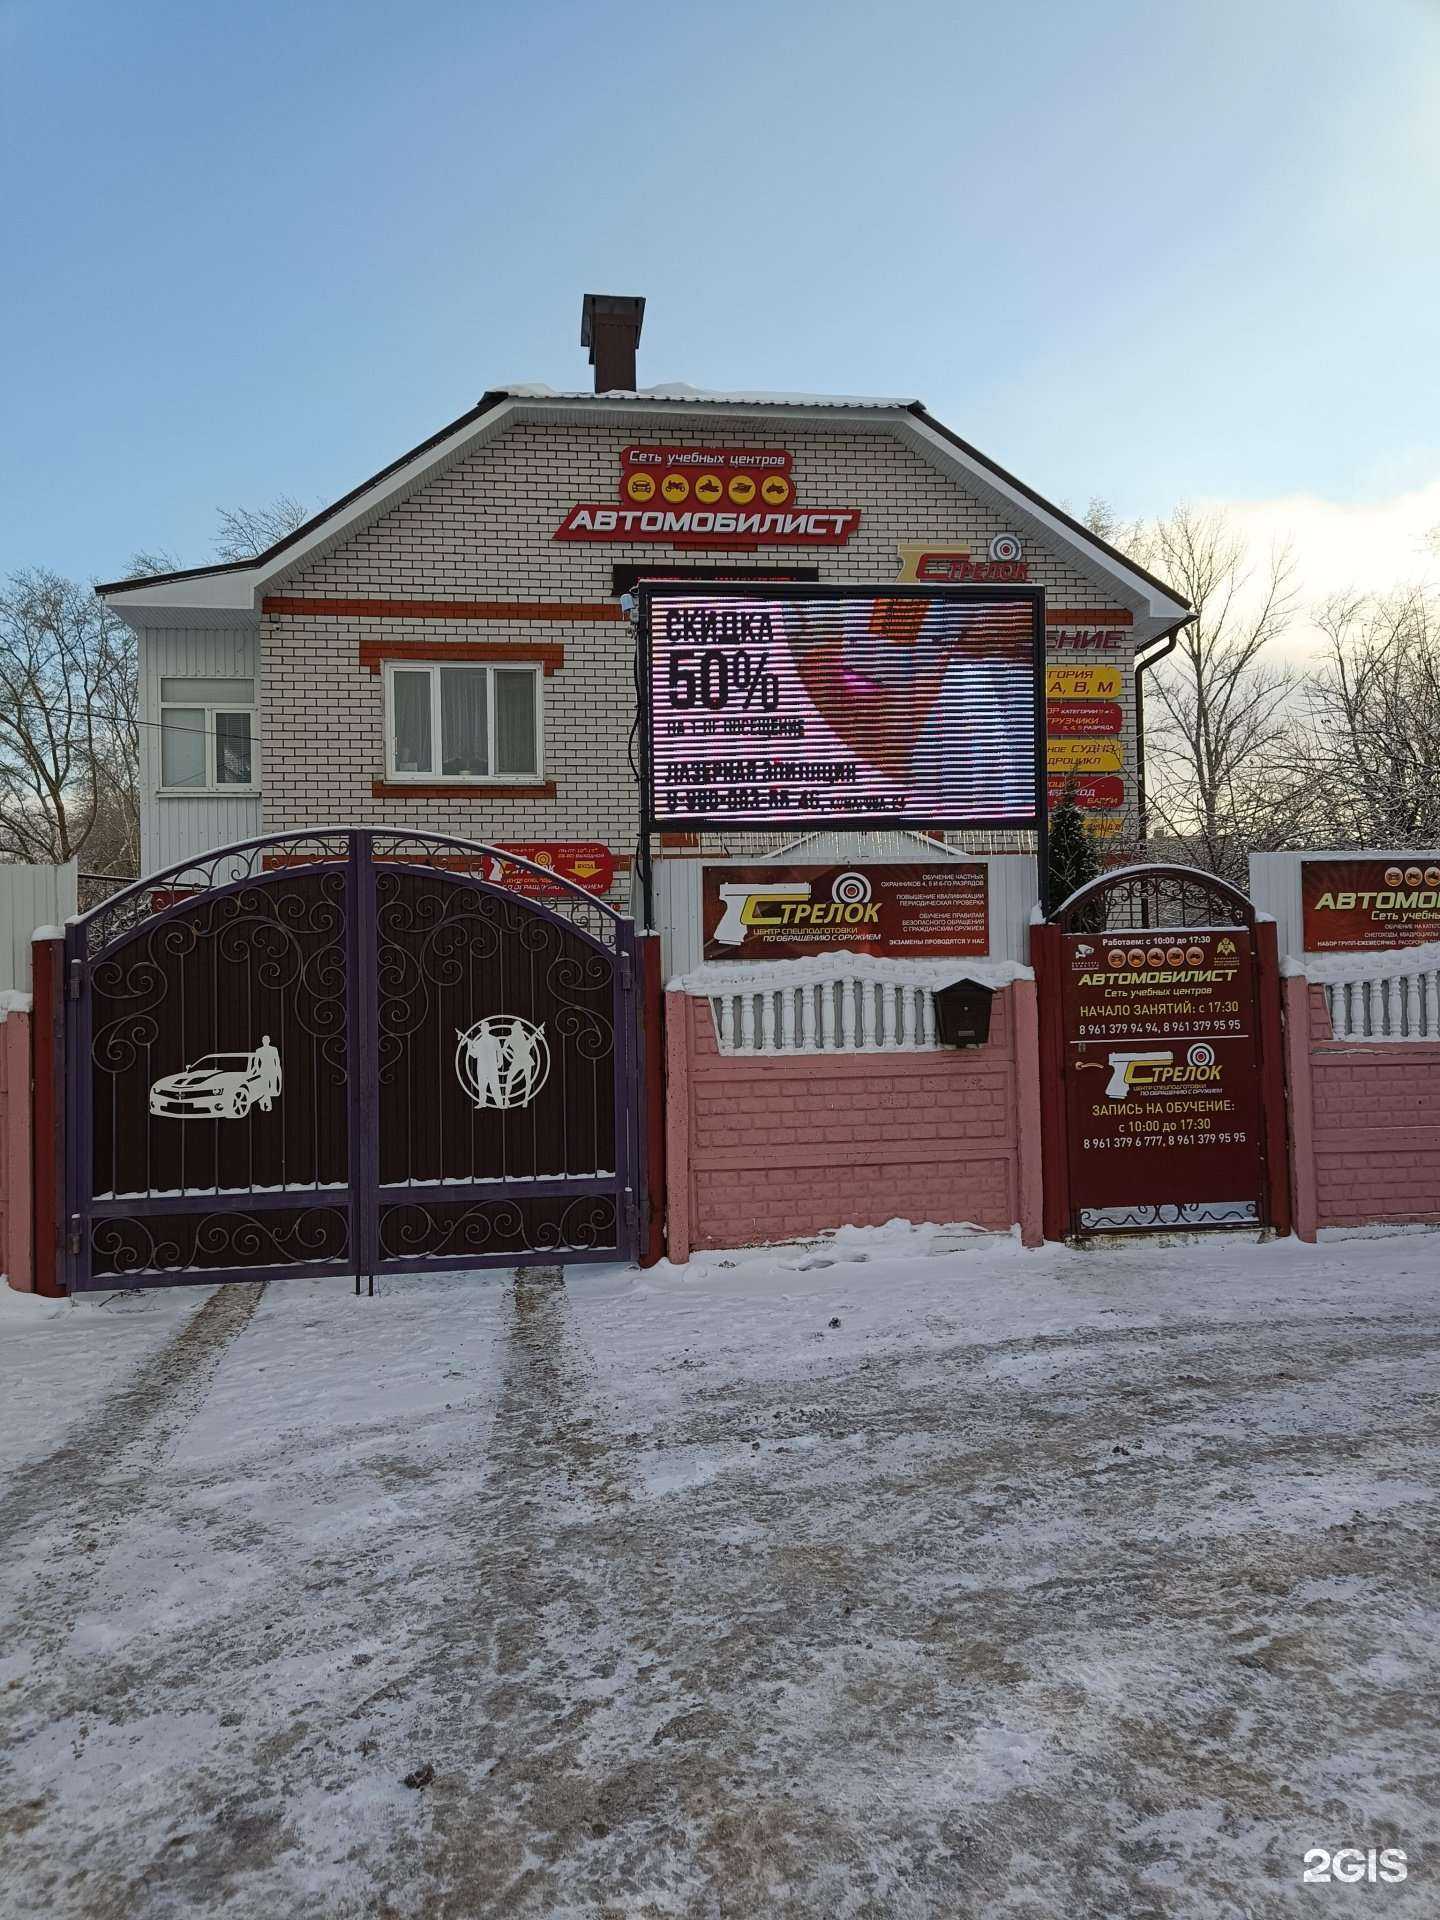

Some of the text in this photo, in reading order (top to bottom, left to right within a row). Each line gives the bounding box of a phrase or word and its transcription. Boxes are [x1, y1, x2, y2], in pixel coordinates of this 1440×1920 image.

[629, 450, 786, 467] Сеть учебных центров
[568, 509, 854, 536] АВТОМОБИЛИСТ
[669, 650, 779, 711] 50%
[740, 893, 883, 925] СТРЕЛОК
[1314, 891, 1440, 910] АВТОМО
[1371, 910, 1399, 921] Сеть
[753, 927, 858, 935] ЦЕНТР СПЕЦПОДГОТОВКИ
[776, 934, 831, 942] ОБРАЩЕНИЮ
[1102, 938, 1144, 946] Работаем:
[1078, 969, 1238, 986] АВТОМОБИЛИСТ
[1104, 986, 1213, 998] Сеть учебных центров
[1080, 1000, 1239, 1017] НАЧАЛО ЗАНЯТИЙ: с 17:30
[1079, 1019, 1241, 1035] 8 961 379 94 94, 8 961 379 95 95
[1124, 1059, 1223, 1084] СТРЕЛОК
[1092, 1100, 1235, 1116] ЗАПИСЬ НА ОБУЧЕНИЕ:
[1118, 1118, 1211, 1133] с 10:00 до 17:30
[1083, 1138, 1090, 1149] 8
[1093, 1138, 1111, 1148] 961
[1113, 1137, 1132, 1148] 379
[1135, 1136, 1142, 1147] 6
[1168, 1135, 1175, 1145] 8
[1177, 1134, 1195, 1145] 961
[1197, 1134, 1216, 1144] 379
[1218, 1133, 1231, 1143] 95
[1233, 1132, 1246, 1143] 95
